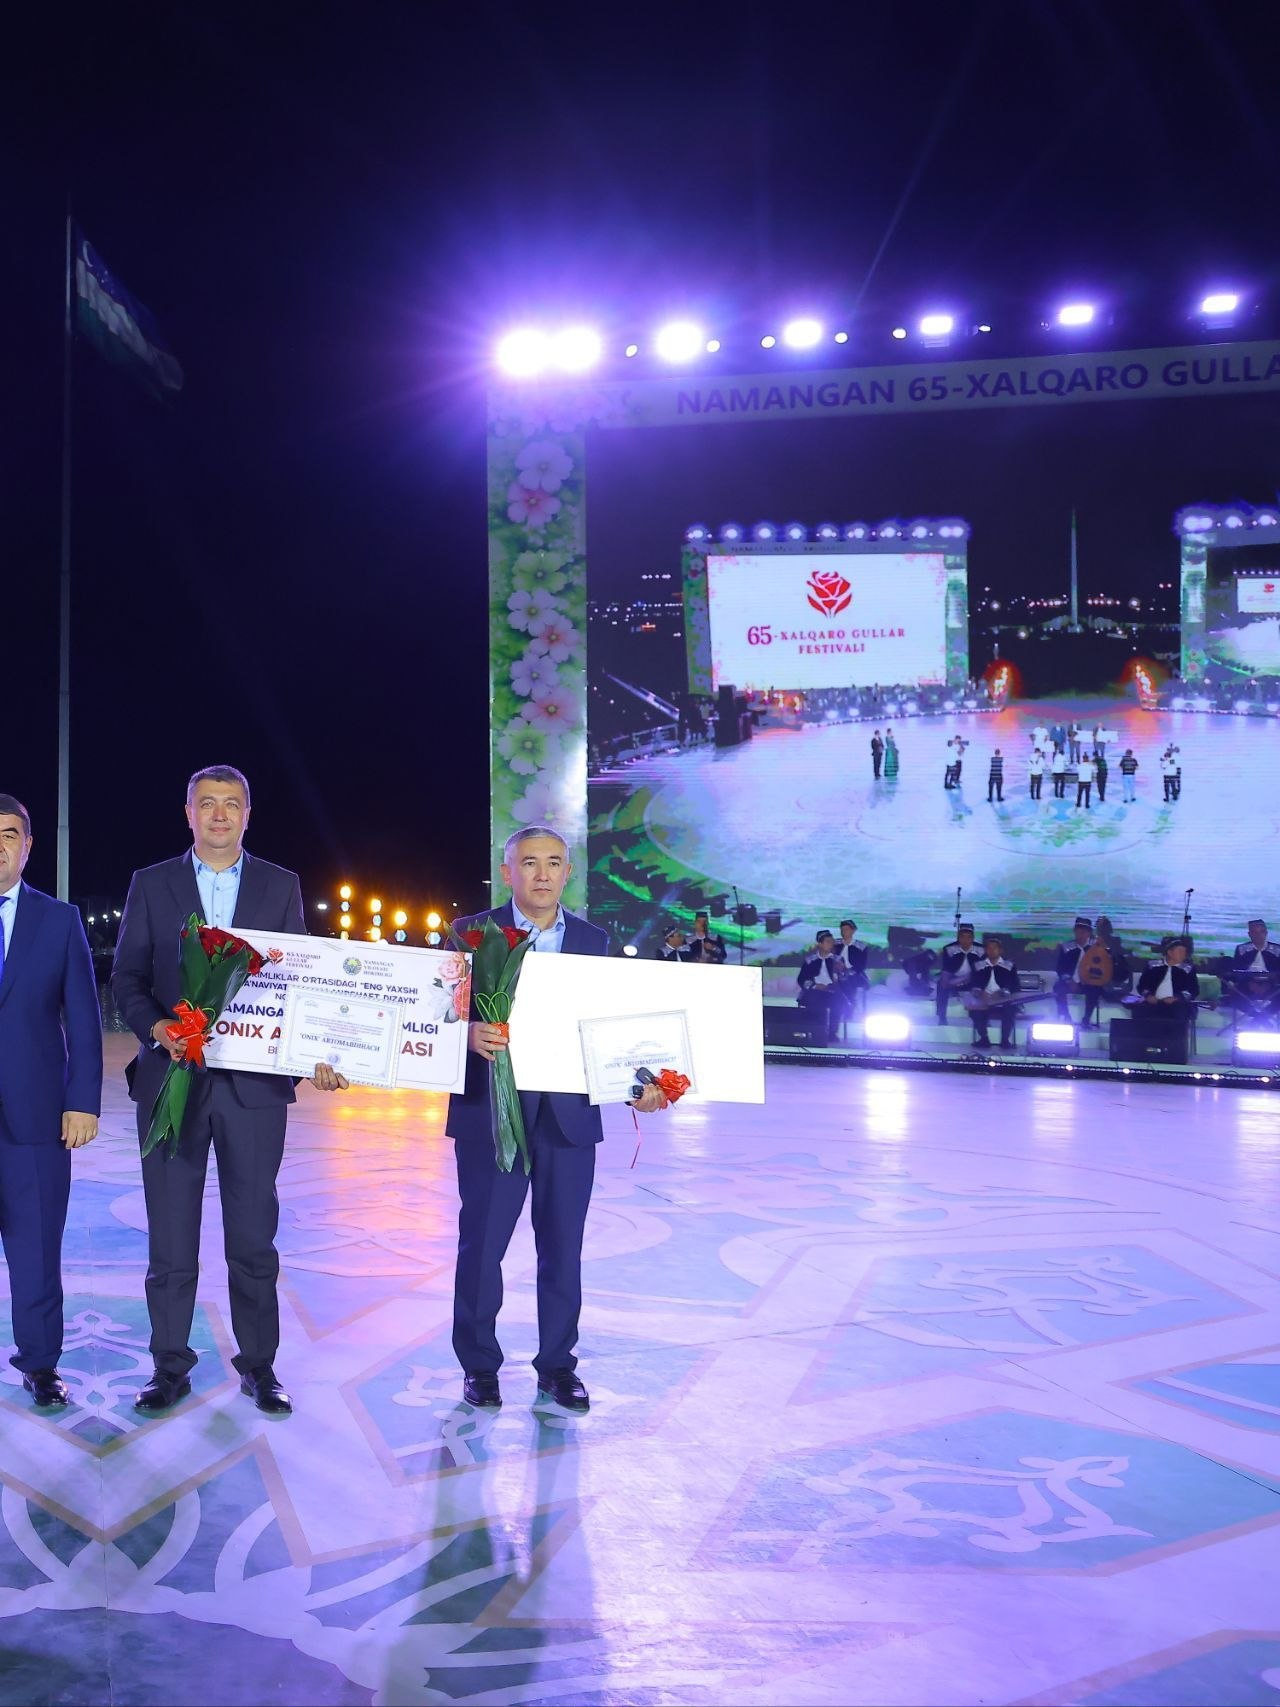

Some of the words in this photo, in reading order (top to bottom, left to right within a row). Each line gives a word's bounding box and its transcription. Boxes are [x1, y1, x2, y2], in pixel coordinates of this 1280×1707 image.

[676, 379, 895, 414] NAMANGAN
[908, 363, 1148, 402] 65-XALQARO
[1162, 354, 1280, 387] GULLA
[747, 625, 846, 646] 65-XALQARO
[852, 628, 905, 639] GULLAR
[799, 643, 865, 655] FESTIVALI
[244, 980, 288, 991] A'NAVIYAT
[386, 985, 418, 995] YAXSHI
[224, 1003, 284, 1018] AMANGA
[402, 1021, 439, 1035] MLIGI
[215, 1020, 264, 1039] ONIX
